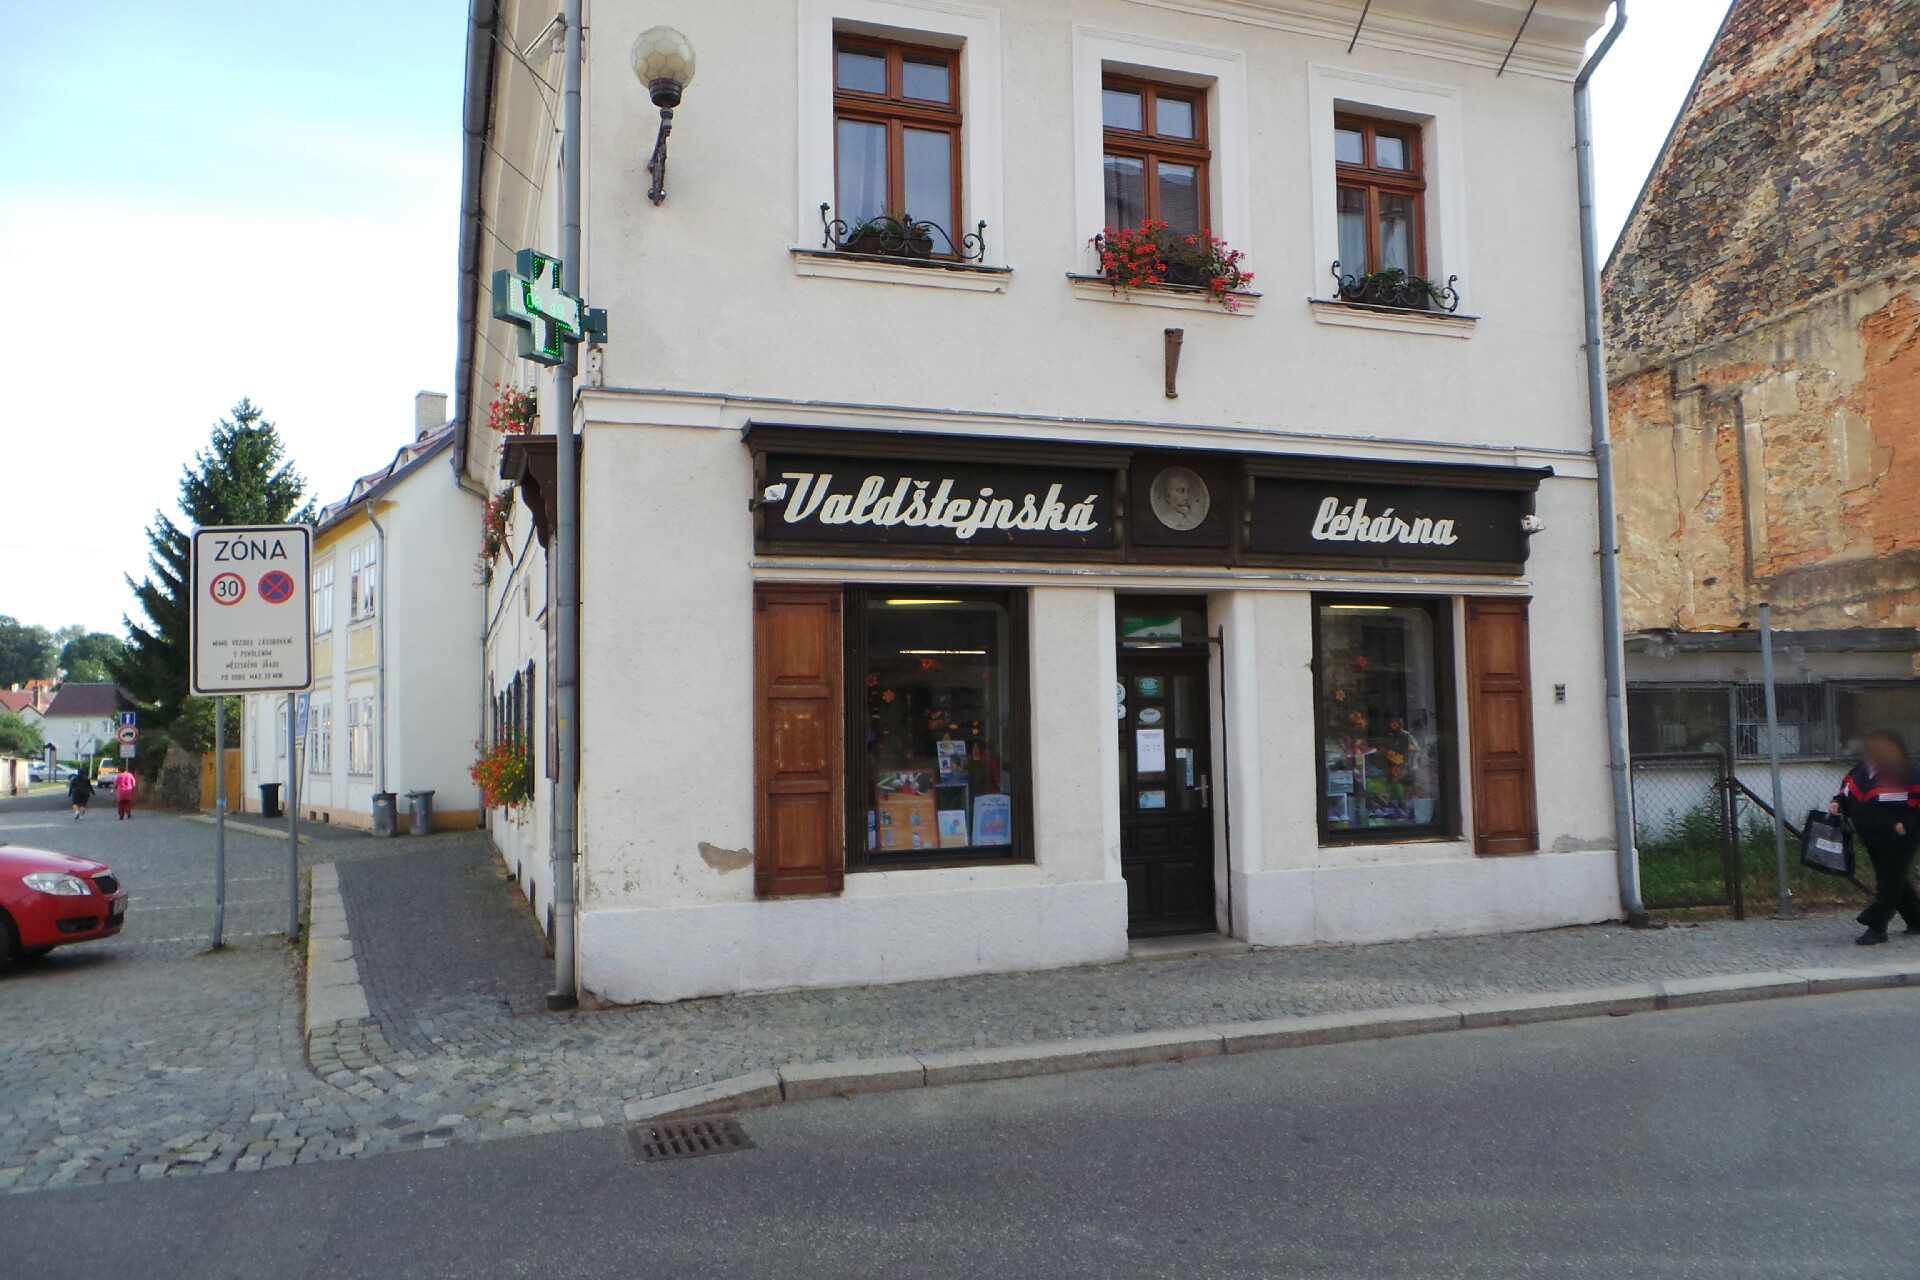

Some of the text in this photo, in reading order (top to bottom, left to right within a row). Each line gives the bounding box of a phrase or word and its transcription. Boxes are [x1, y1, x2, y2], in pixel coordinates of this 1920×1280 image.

[782, 472, 1459, 546] Valdštejnská lékárna
[214, 535, 287, 561] ZÓNA
[217, 580, 239, 597] 30
[258, 637, 292, 646] ZÁSOBOVÁNÍ
[226, 660, 280, 669] MĚSTSKÉHO ÚŘADU
[297, 697, 306, 723] P
